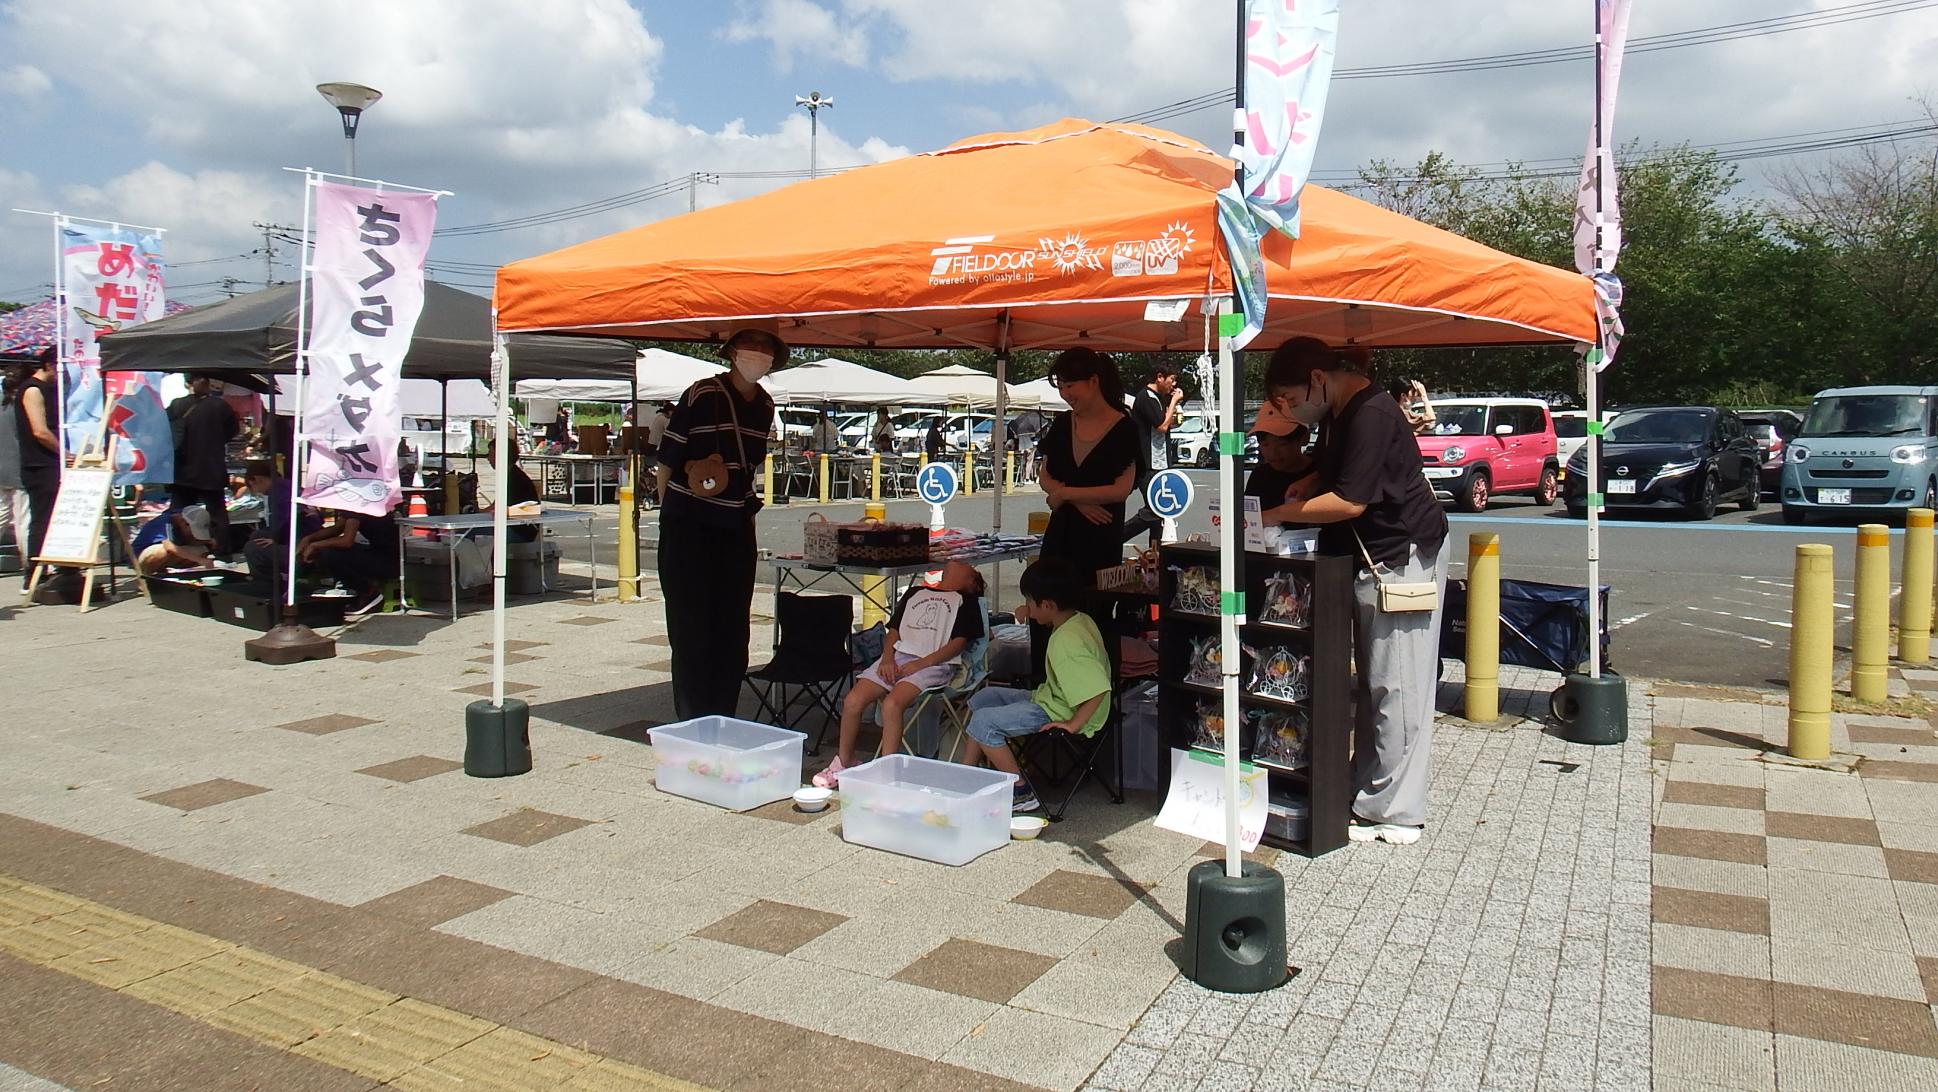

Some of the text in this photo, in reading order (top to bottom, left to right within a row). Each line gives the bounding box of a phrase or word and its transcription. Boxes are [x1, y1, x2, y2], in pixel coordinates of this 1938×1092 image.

[952, 250, 1036, 274] FIELDOOR
[1147, 253, 1170, 269] UV
[928, 273, 966, 287] Powered
[968, 272, 980, 286] by
